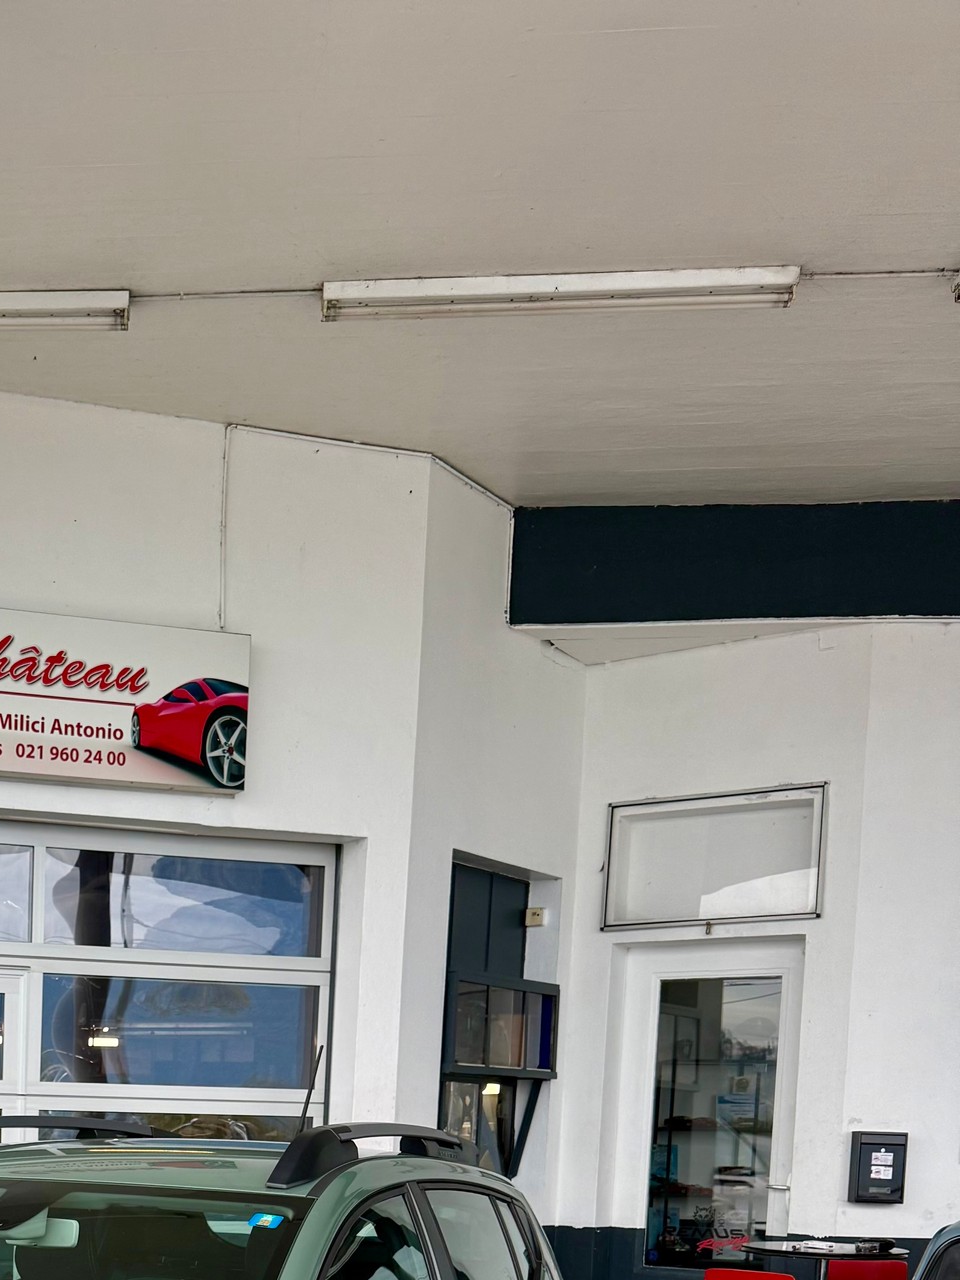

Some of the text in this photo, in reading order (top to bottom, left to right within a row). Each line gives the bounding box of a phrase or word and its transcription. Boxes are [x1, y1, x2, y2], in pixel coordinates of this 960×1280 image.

[50, 718, 124, 741] Antonio
[15, 743, 127, 766] 021 960 24 00
[662, 1226, 745, 1239] REMUS
